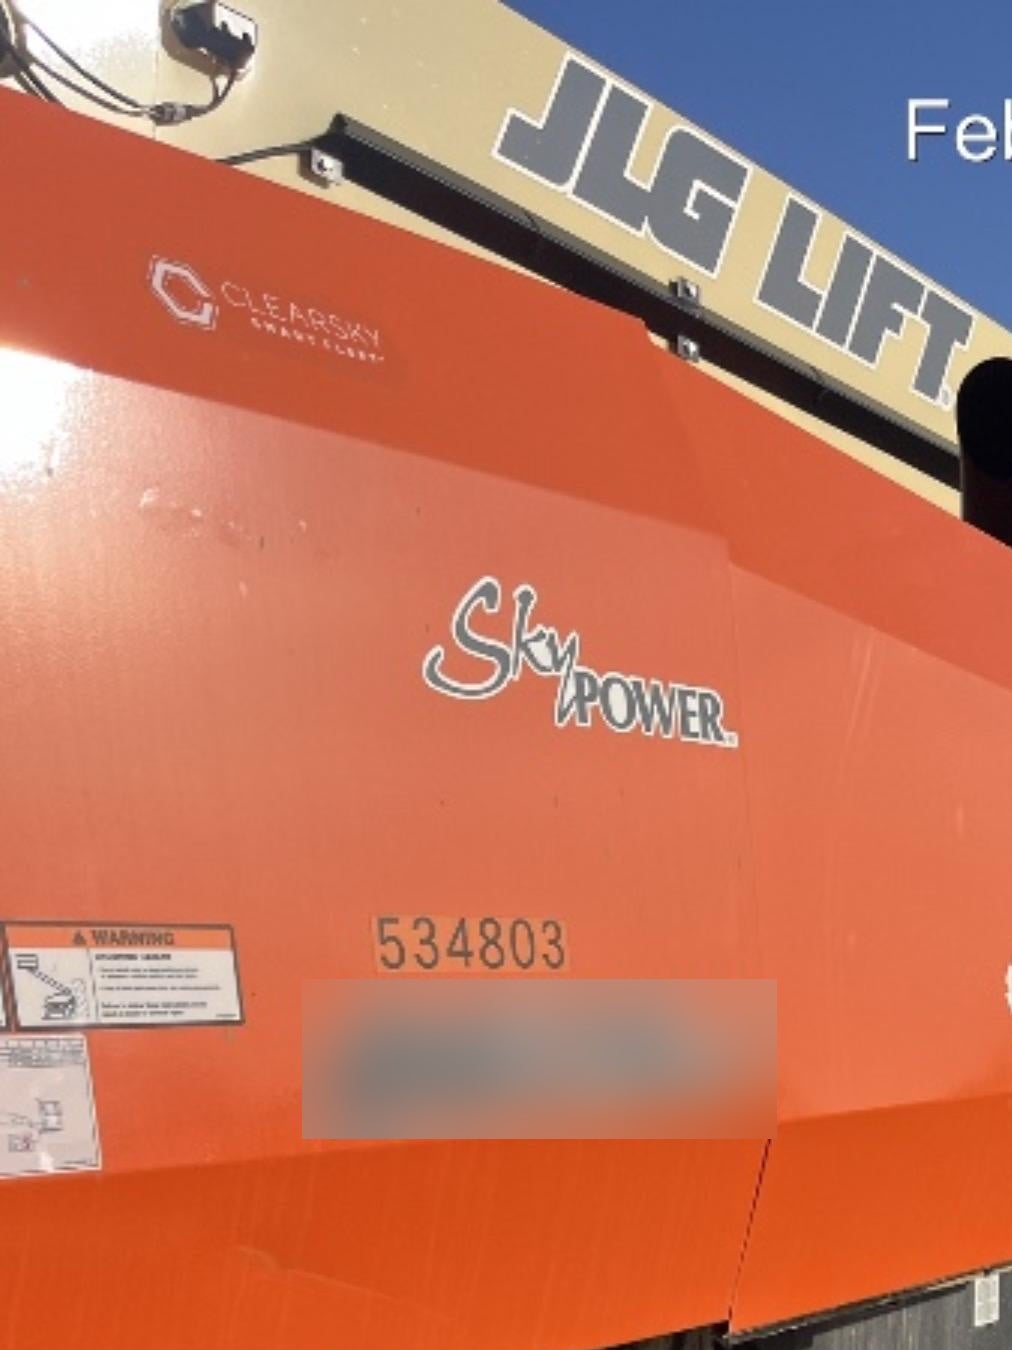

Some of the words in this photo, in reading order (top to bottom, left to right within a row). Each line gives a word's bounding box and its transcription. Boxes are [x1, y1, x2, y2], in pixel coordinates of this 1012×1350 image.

[491, 51, 755, 279] JLG
[753, 191, 976, 405] LIFT
[220, 280, 381, 347] CLEARSKY
[422, 575, 579, 727] Sky
[570, 667, 729, 745] POWER
[91, 929, 175, 947] WARNING
[376, 917, 566, 970] 534803
